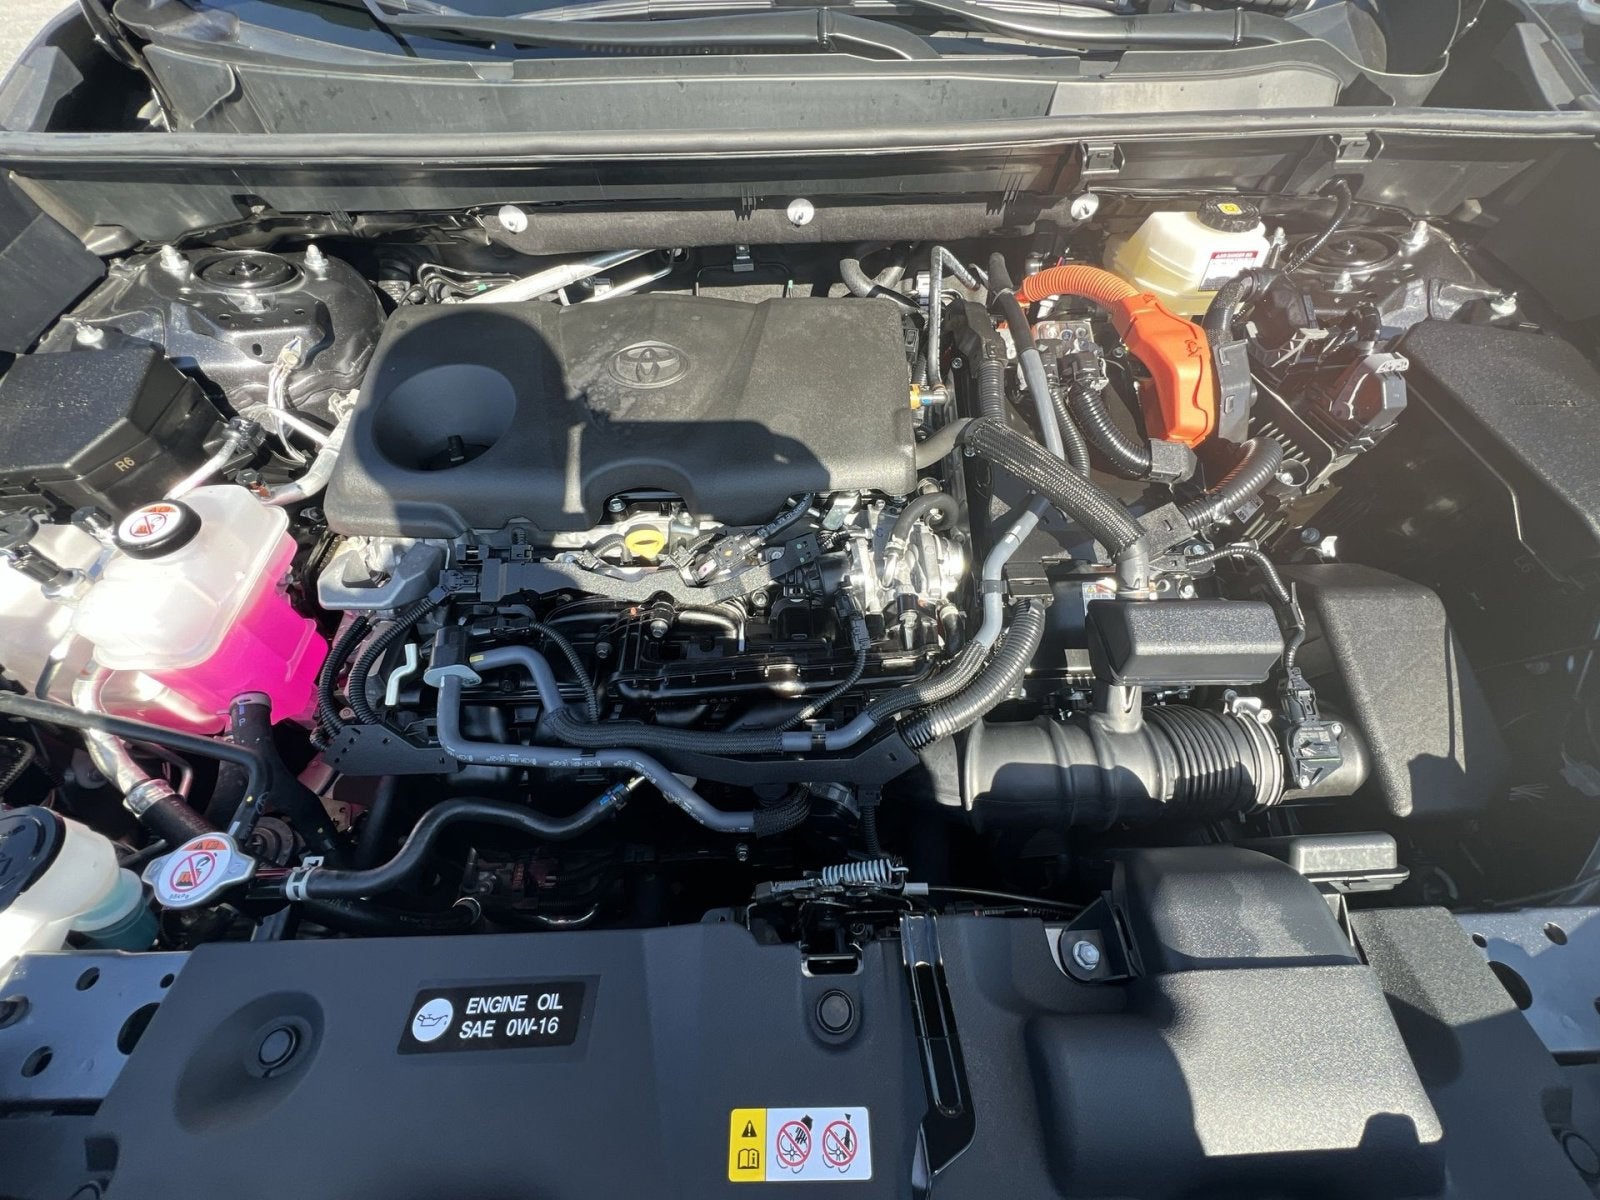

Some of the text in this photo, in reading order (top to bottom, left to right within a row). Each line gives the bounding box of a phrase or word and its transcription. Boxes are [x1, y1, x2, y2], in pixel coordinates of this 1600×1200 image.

[114, 456, 136, 472] R6
[465, 993, 563, 1015] ENGINE OIL
[459, 1016, 559, 1039] SAE 0W-16
